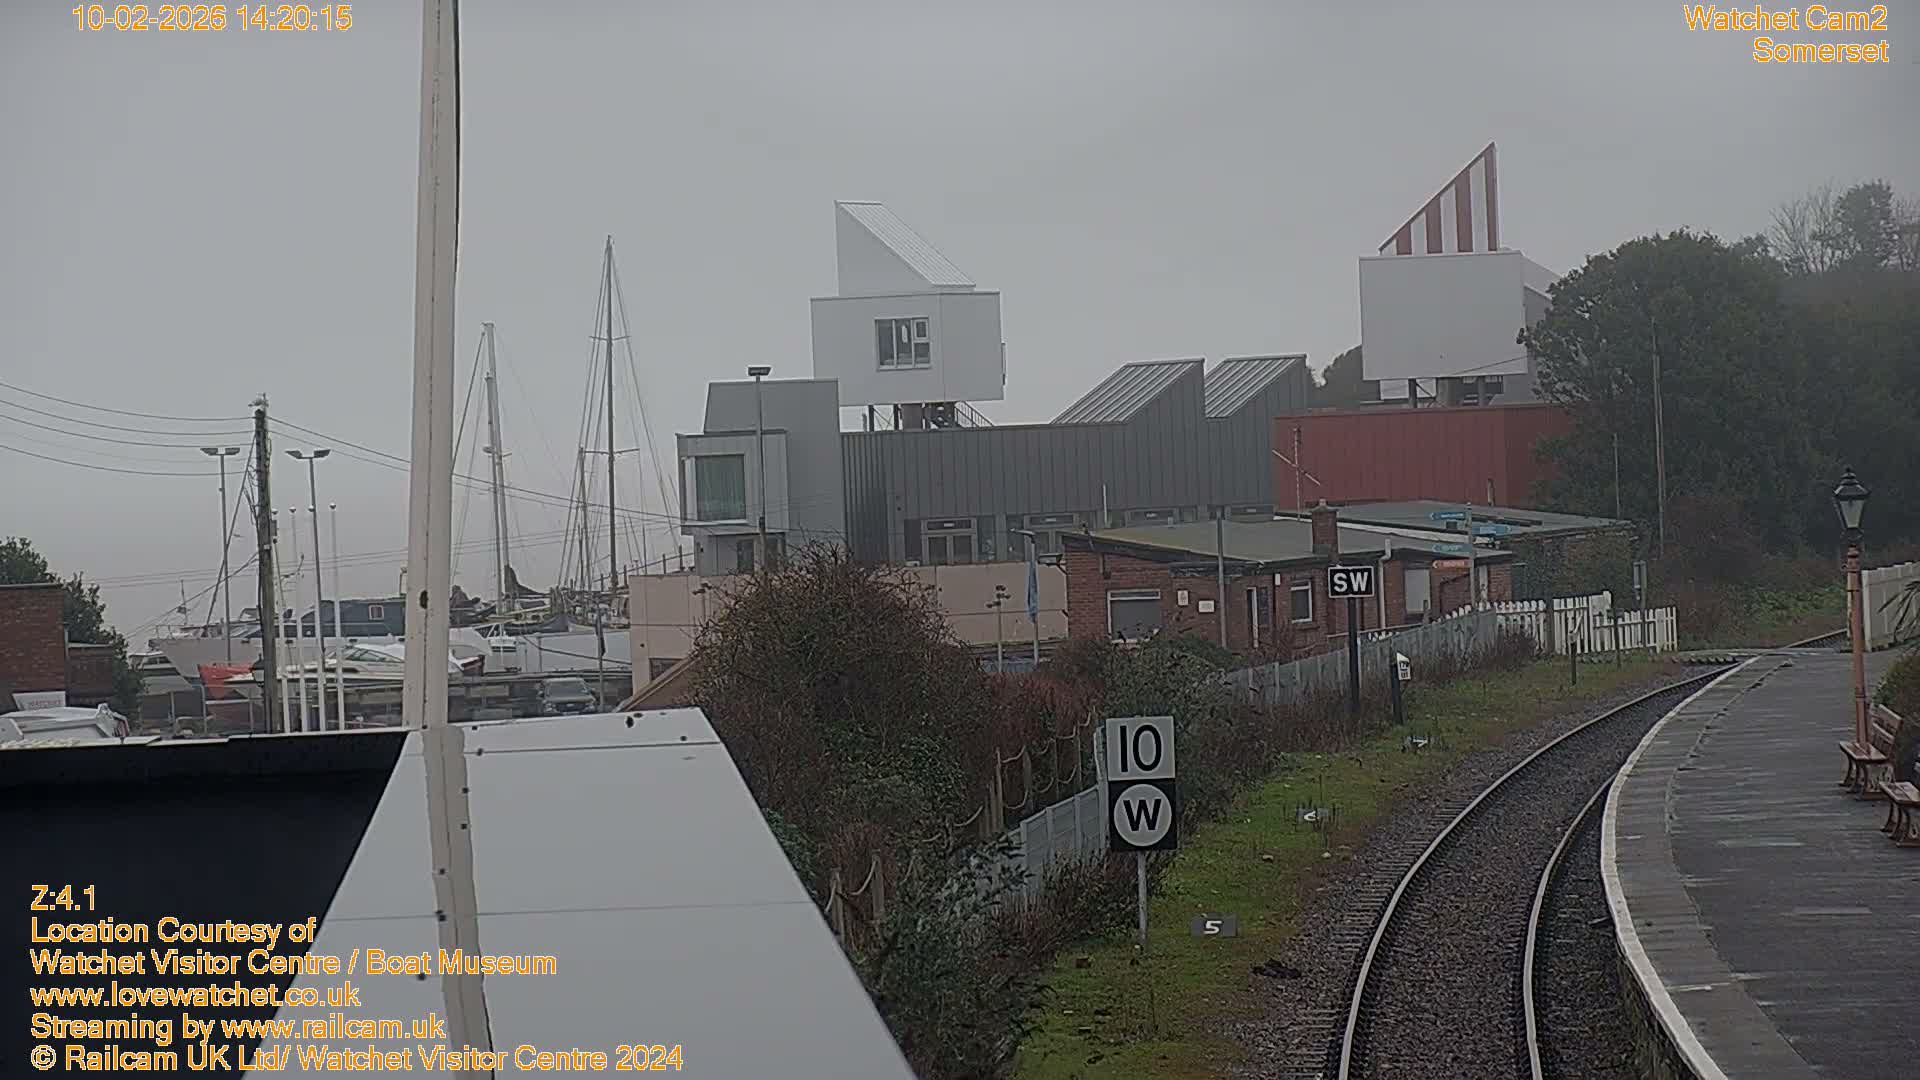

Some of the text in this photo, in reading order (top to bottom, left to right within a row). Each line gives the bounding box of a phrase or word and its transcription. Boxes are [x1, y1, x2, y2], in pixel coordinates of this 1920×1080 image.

[1333, 571, 1369, 592] SW
[1119, 723, 1163, 773] 10
[1122, 798, 1162, 832] W
[1203, 920, 1223, 935] 5
